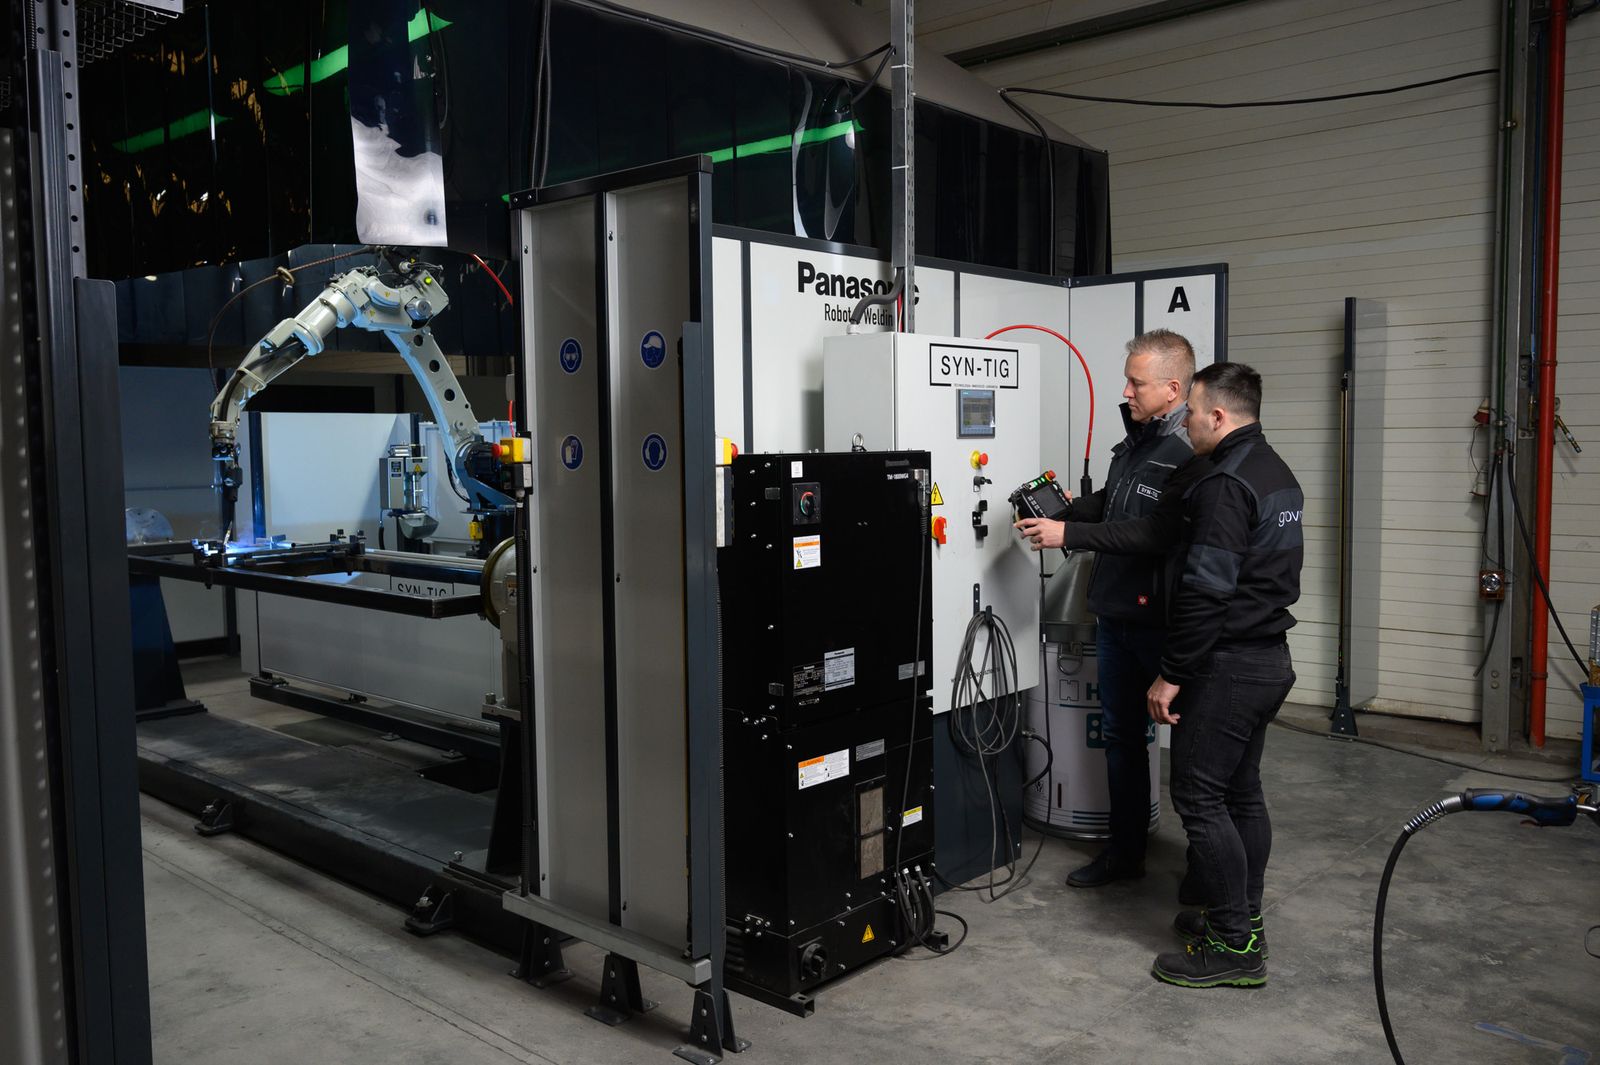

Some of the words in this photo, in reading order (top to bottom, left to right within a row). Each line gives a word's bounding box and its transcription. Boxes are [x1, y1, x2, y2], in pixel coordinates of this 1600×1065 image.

[1168, 286, 1191, 313] A
[864, 307, 893, 326] Weldin
[941, 355, 1009, 378] SYN-TIG
[1278, 510, 1303, 528] gov
